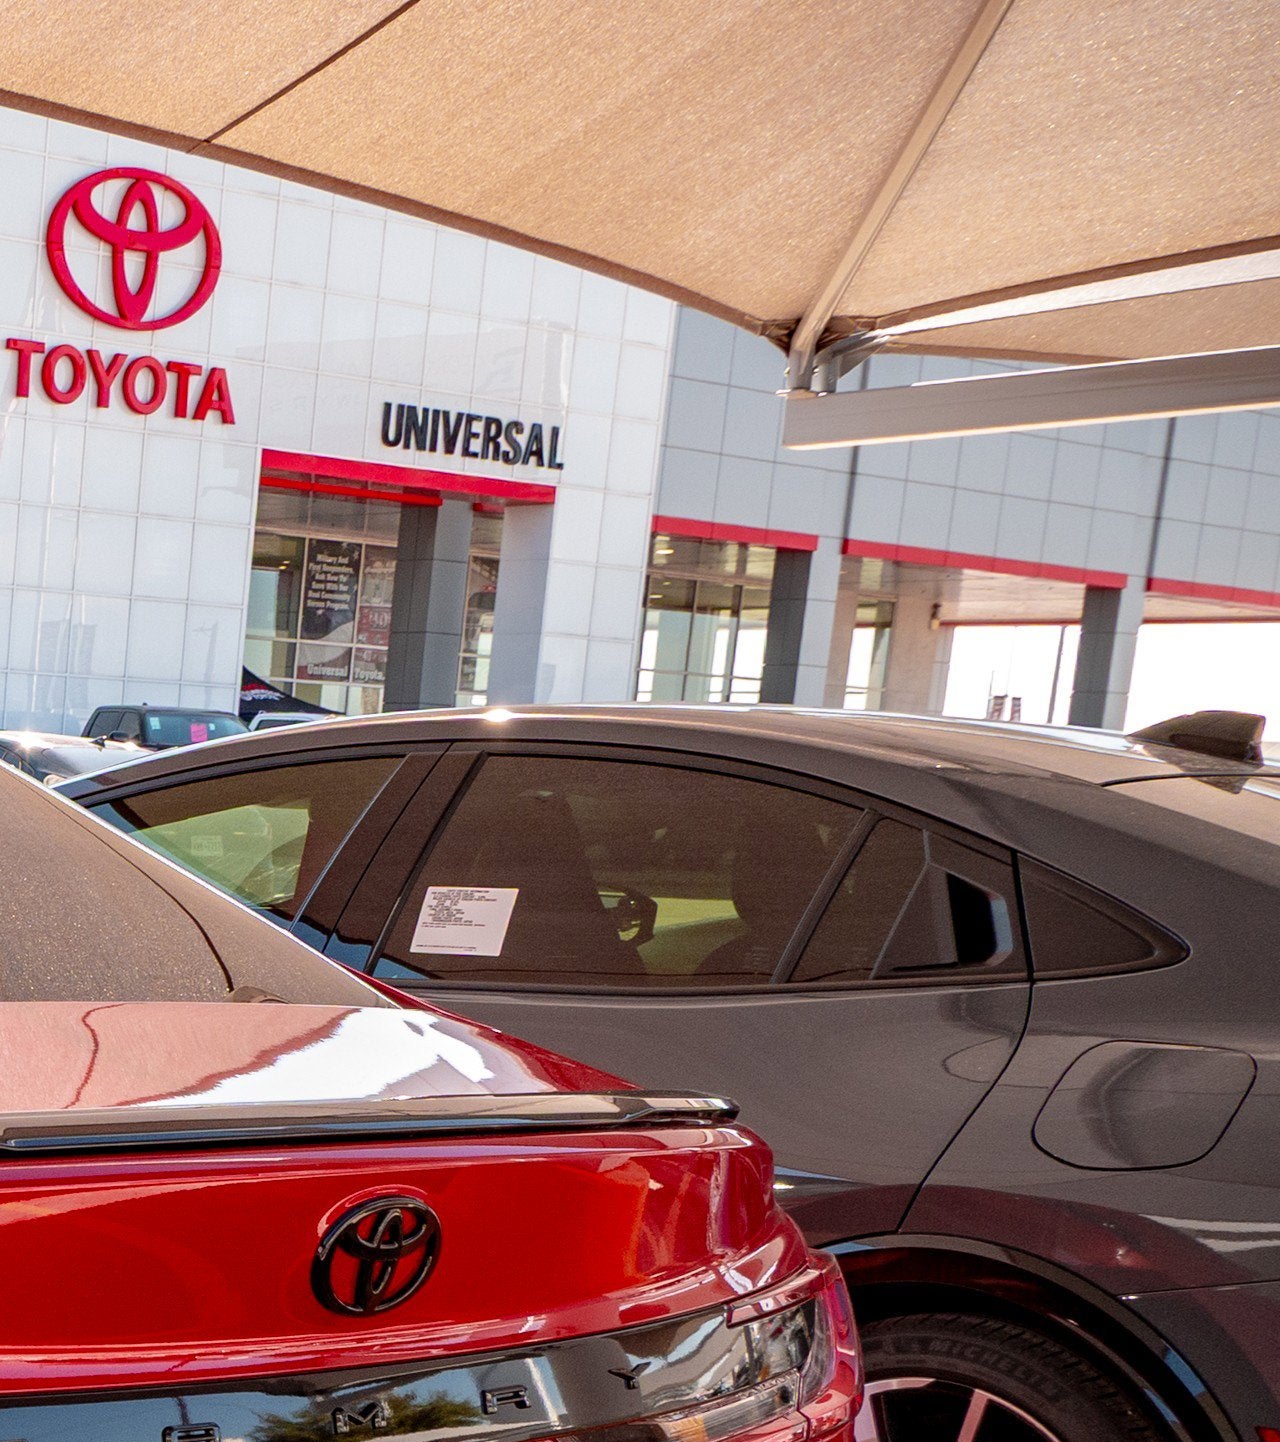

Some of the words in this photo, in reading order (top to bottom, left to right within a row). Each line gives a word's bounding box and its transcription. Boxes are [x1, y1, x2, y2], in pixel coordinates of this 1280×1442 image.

[5, 337, 236, 426] TOYOTA
[380, 401, 565, 471] UNIVERSAL
[307, 663, 348, 677] Universal
